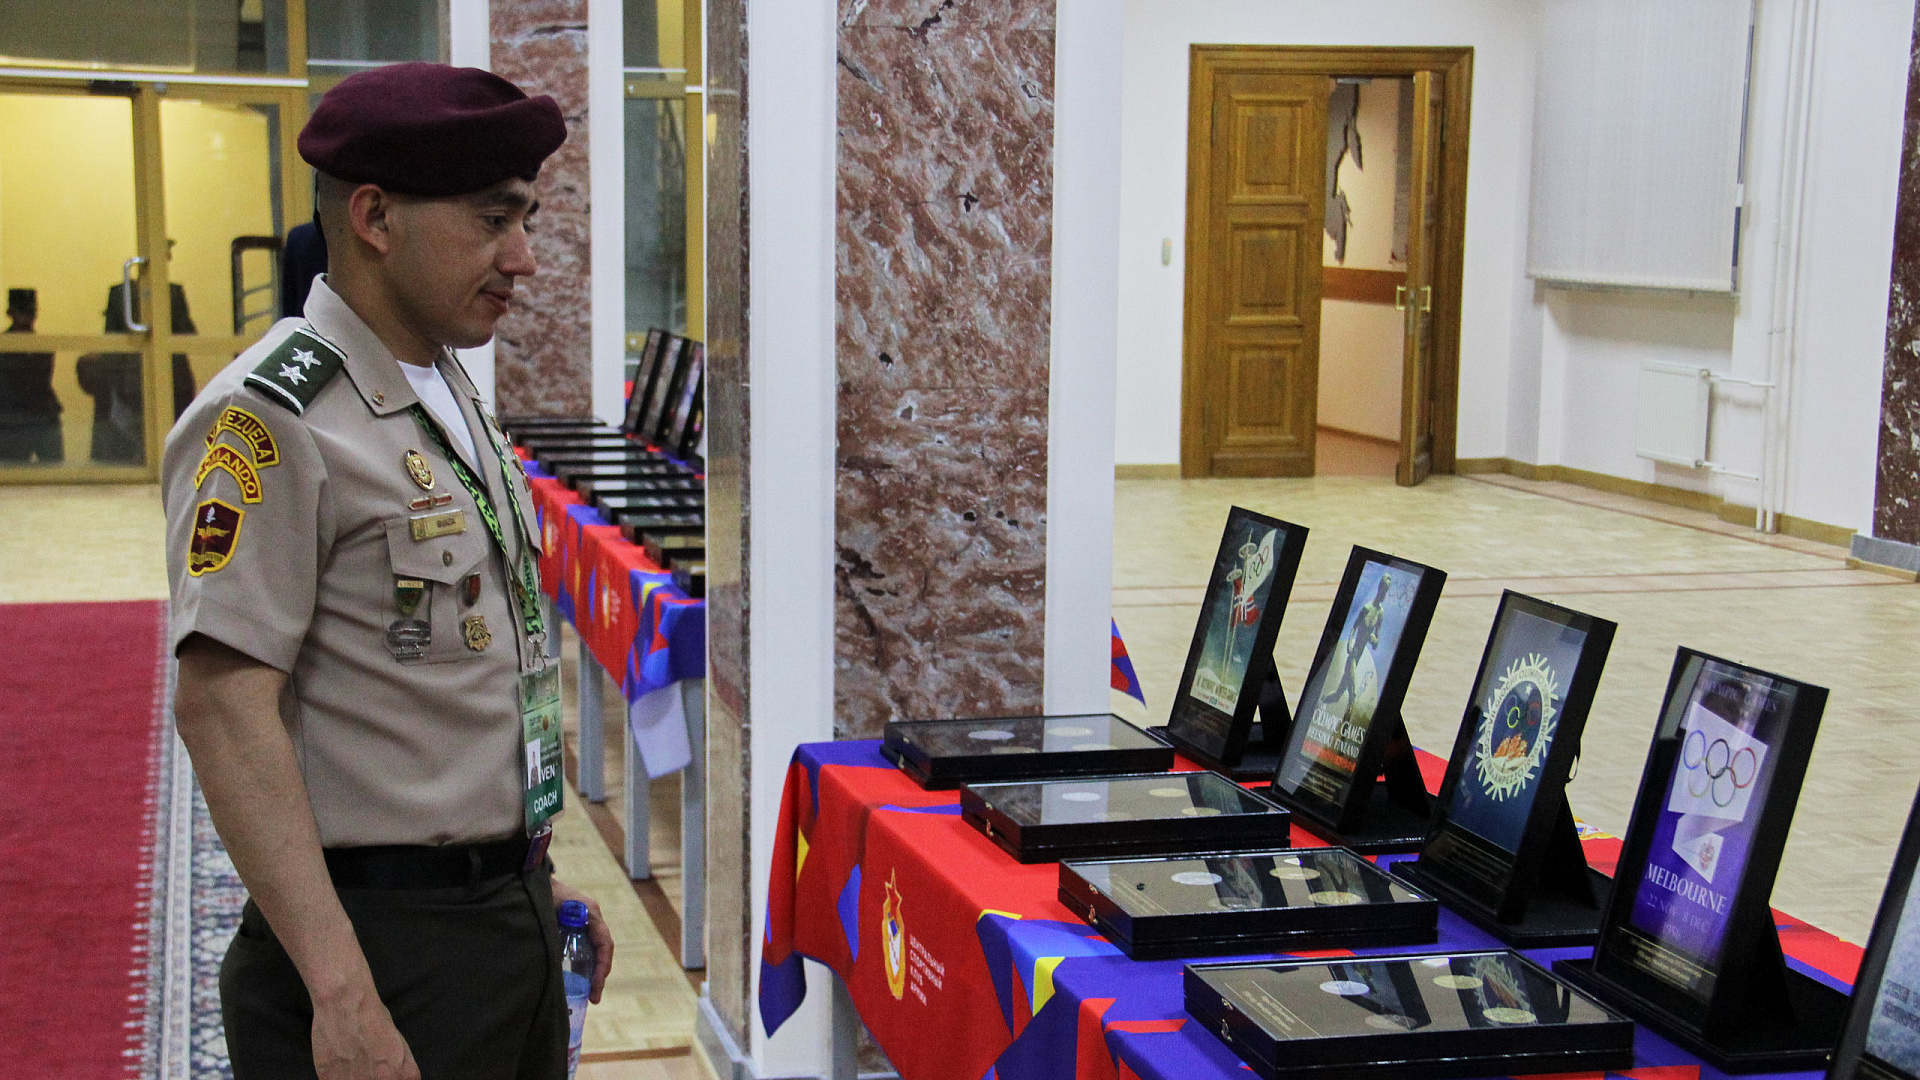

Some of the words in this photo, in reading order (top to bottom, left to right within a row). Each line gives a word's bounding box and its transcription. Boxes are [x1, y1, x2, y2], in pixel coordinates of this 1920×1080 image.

[208, 410, 273, 461] EZUELA
[1312, 708, 1343, 734] OLYMPIC
[1340, 720, 1366, 744] GAMES
[1333, 738, 1360, 758] FINLAND
[541, 765, 555, 781] VEN
[534, 790, 557, 813] COACH
[1645, 862, 1727, 916] MELBOURNE
